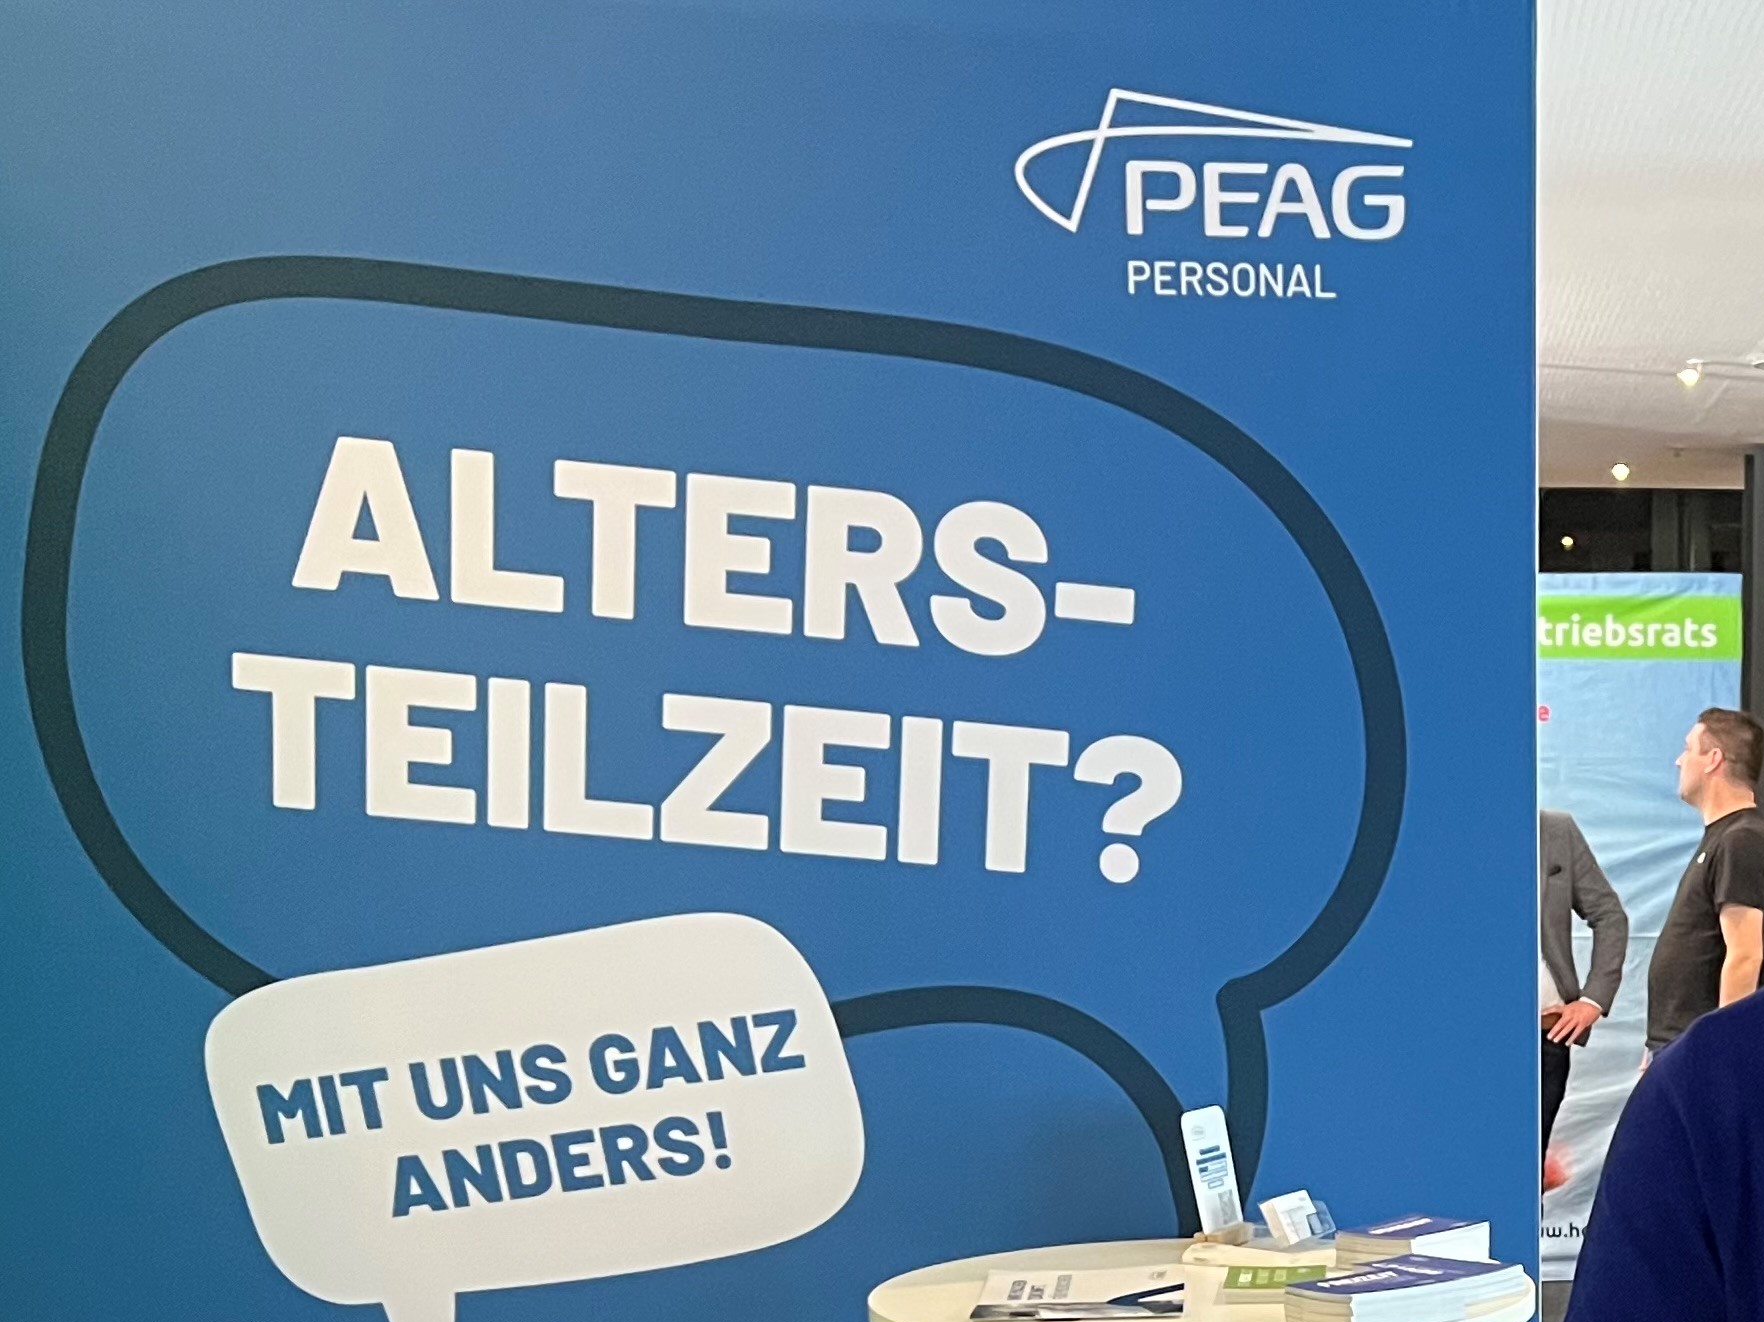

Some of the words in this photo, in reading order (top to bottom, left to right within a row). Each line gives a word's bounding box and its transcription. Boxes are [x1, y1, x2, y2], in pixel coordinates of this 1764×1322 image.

[1125, 160, 1405, 240] PEAG
[1127, 260, 1337, 299] PERSONAL
[291, 436, 1135, 656] ALTERS-
[1538, 613, 1718, 647] triebsrats
[231, 652, 1183, 883] TEILZEIT?
[257, 1067, 389, 1144] MIT
[408, 1044, 572, 1120] UNS
[588, 1009, 806, 1094] GANZ
[391, 1110, 732, 1217] ANDERS!
